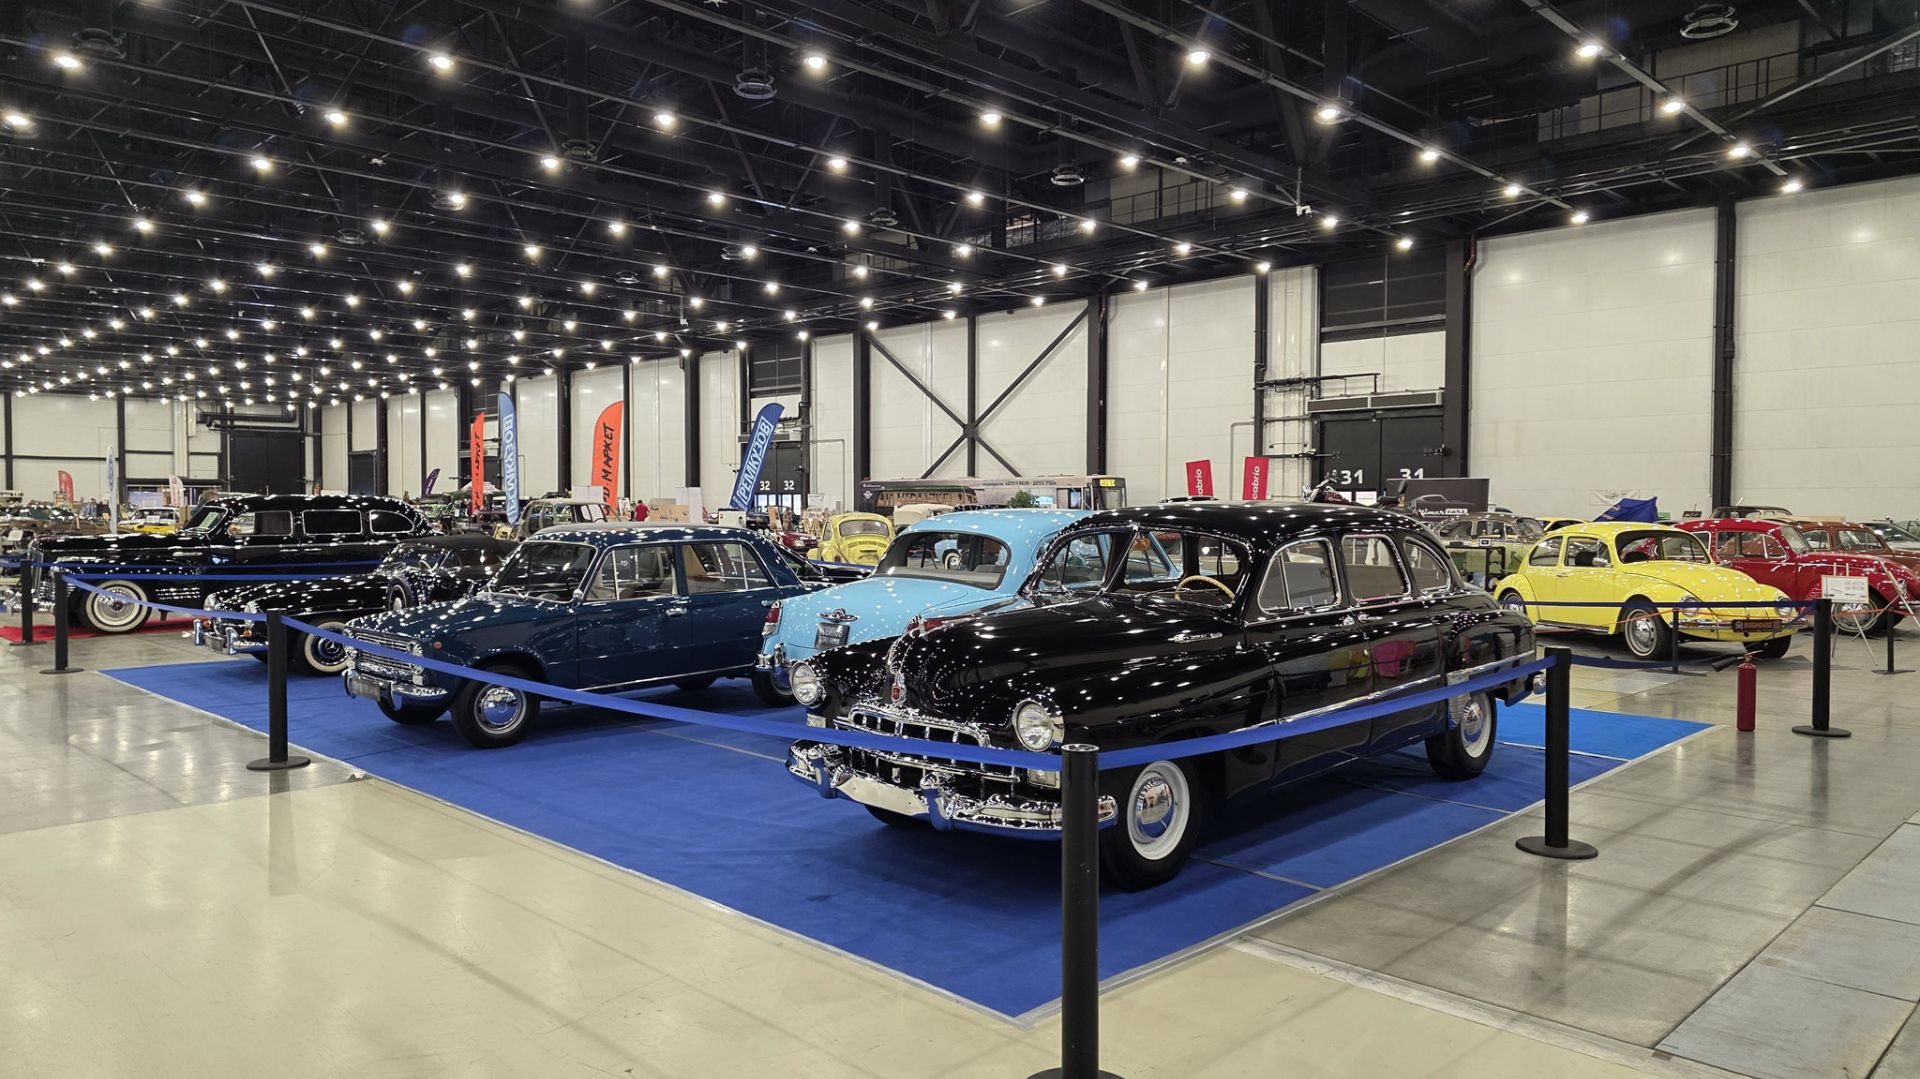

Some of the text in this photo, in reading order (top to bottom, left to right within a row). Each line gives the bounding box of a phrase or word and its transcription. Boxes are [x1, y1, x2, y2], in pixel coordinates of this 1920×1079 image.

[739, 420, 771, 501] РЕМКУЗОВ
[1195, 468, 1204, 495] abrio
[1340, 469, 1364, 485] 31
[1400, 468, 1424, 480] 31
[759, 480, 771, 491] 32
[783, 480, 795, 491] 32
[1251, 465, 1261, 500] cabrio
